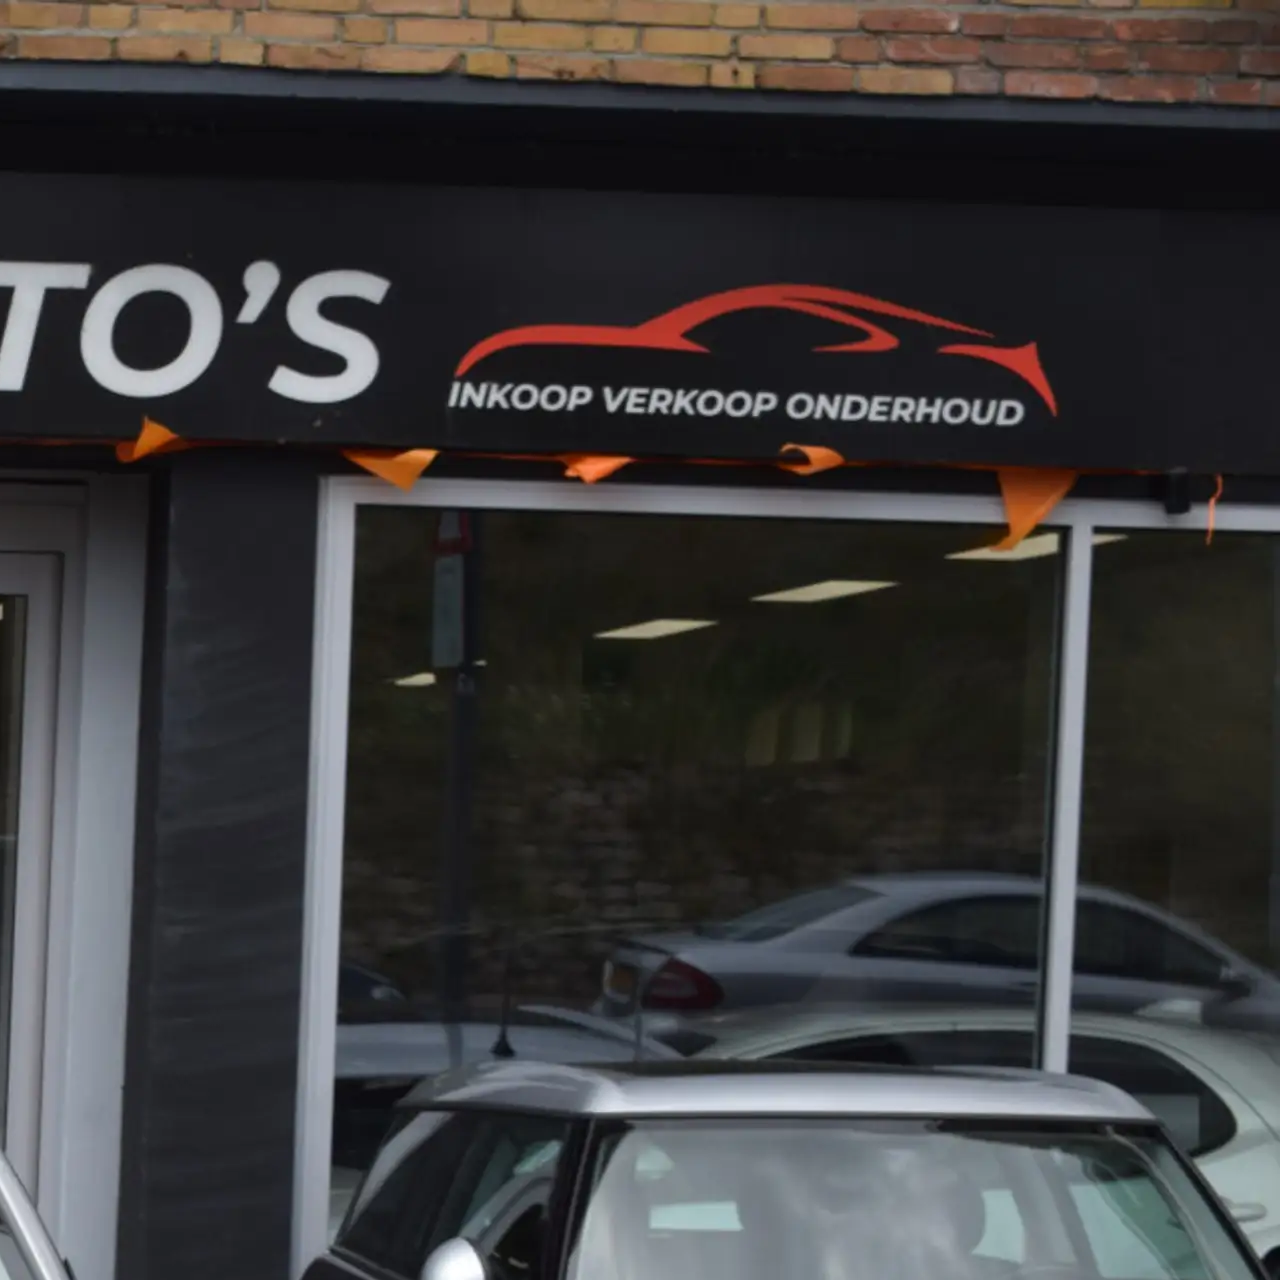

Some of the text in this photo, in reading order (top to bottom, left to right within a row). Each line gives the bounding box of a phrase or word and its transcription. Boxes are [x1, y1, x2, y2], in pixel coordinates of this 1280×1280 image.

[448, 381, 1024, 427] INKOOP VERKOOP ONDERHOUD
